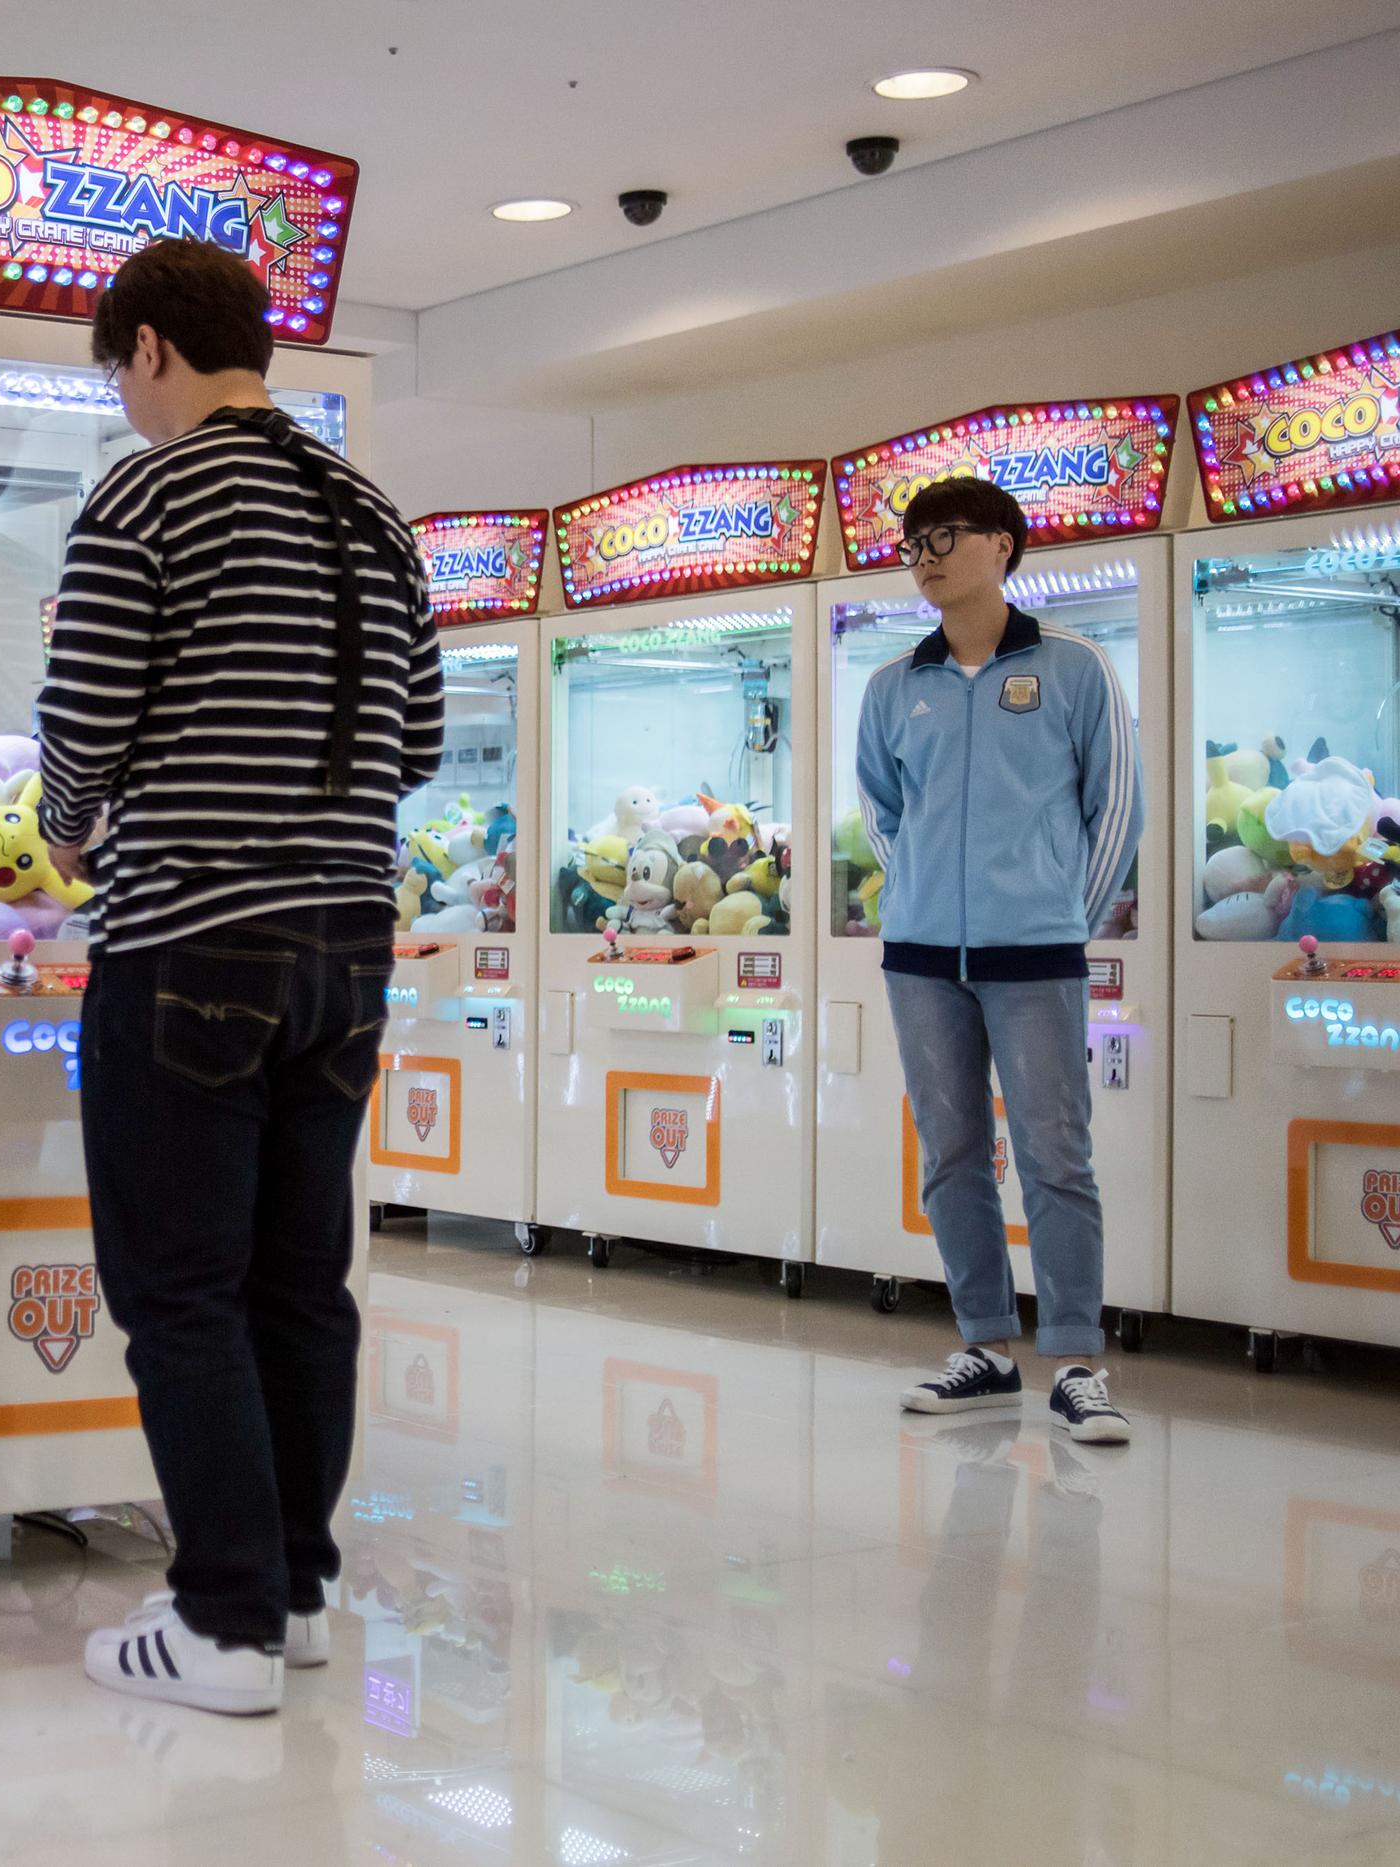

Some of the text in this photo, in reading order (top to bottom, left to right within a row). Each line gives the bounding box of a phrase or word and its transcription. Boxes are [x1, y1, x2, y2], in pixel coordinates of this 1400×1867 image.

[42, 160, 251, 255] ZZANG
[88, 229, 150, 257] GAME
[1264, 394, 1380, 457] COCO
[1328, 436, 1377, 461] HAPPY
[989, 444, 1109, 491] ZZANG
[600, 513, 669, 561] COCO
[679, 503, 773, 543] ZZANG
[432, 547, 507, 582] ZZANG
[1304, 547, 1378, 575] COCO
[618, 633, 662, 653] COCO
[408, 1088, 437, 1104] PRIZE
[407, 1103, 437, 1126] OUT
[651, 1108, 687, 1127] PRIZE
[650, 1127, 688, 1151] OUT
[1363, 1170, 1400, 1193] PRI
[1361, 1192, 1400, 1224] OU
[11, 1264, 98, 1299] PRIZE
[8, 1297, 99, 1341] OUT
